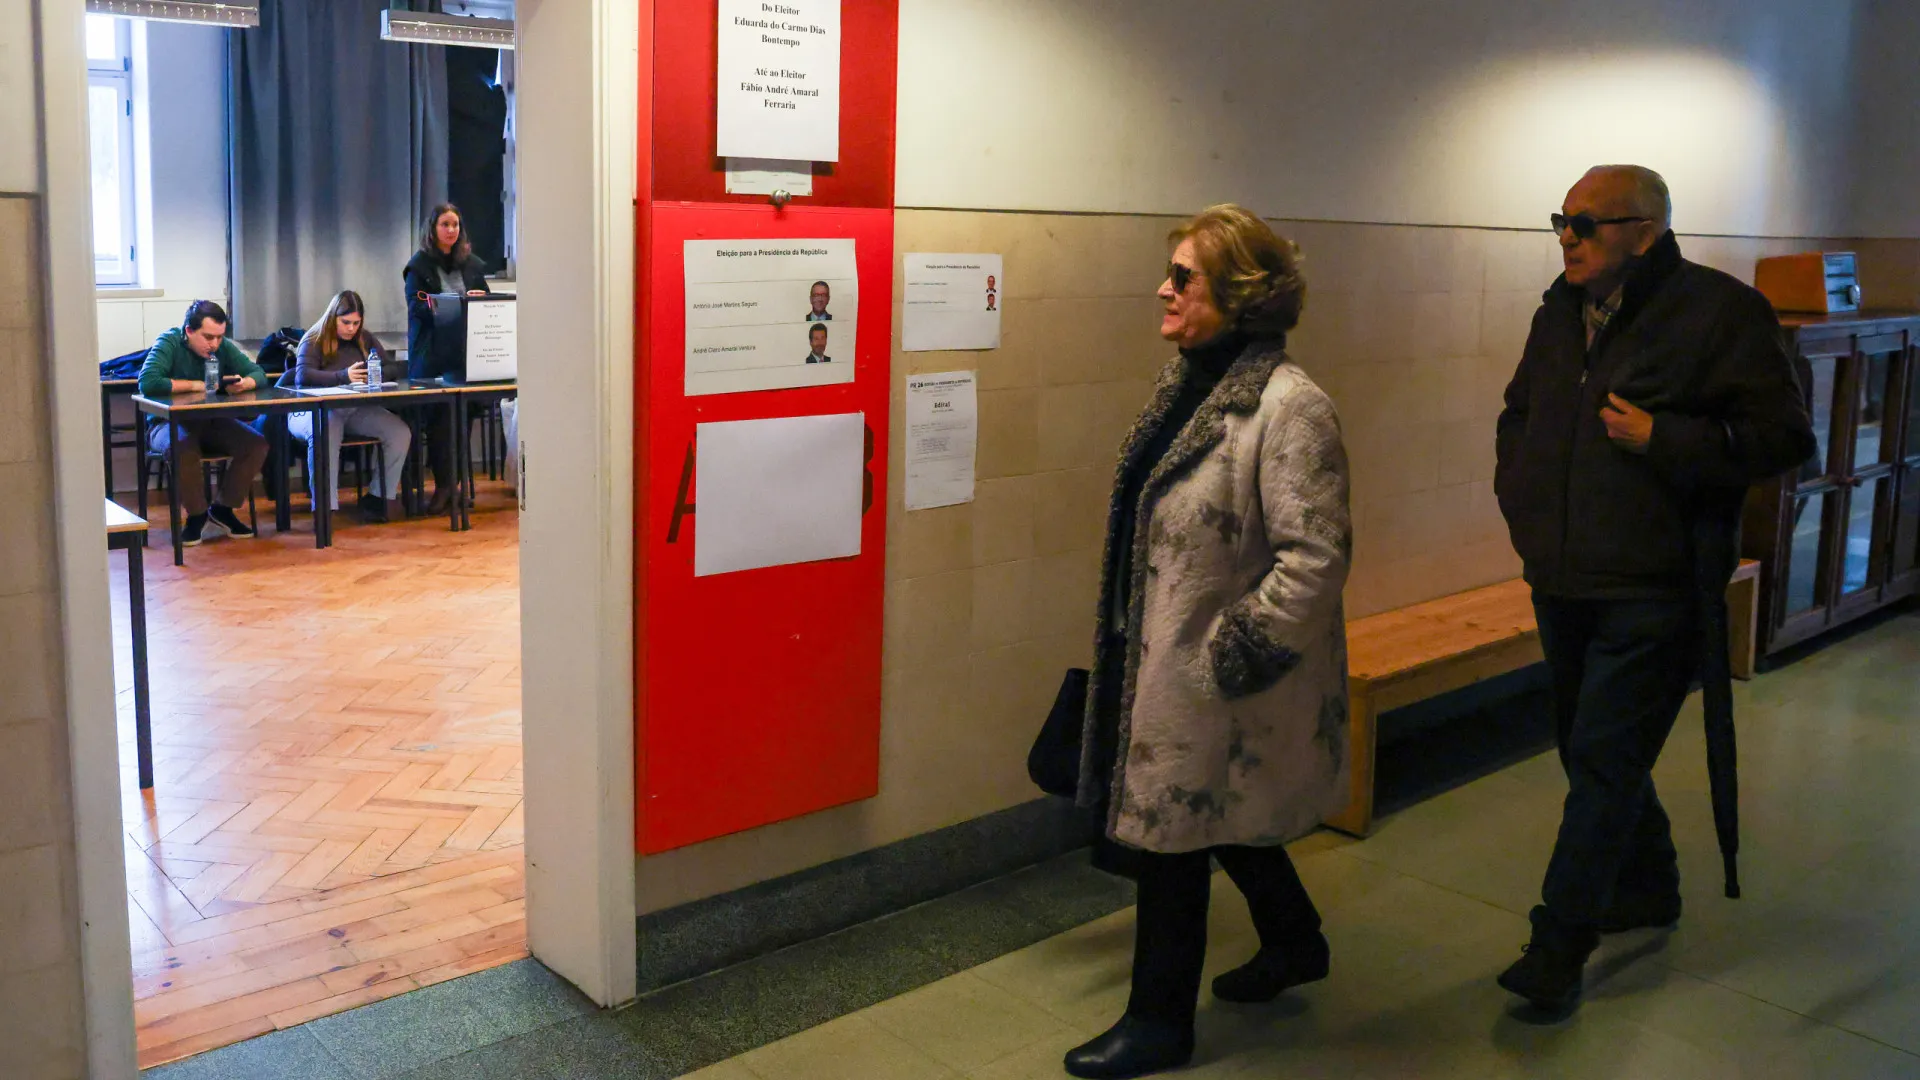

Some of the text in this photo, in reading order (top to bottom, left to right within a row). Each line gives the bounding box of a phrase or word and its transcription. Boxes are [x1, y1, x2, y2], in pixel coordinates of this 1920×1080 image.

[762, 3, 800, 16] Do Eleitor
[734, 16, 826, 35] Eduarda do Carmo Dias
[761, 34, 800, 48] Bontempo
[755, 67, 806, 80] Até ao Eleitor
[741, 82, 819, 97] Fábio André Amaral
[764, 99, 796, 110] Ferraria
[716, 250, 738, 258] Eleição
[739, 250, 753, 258] para
[758, 249, 791, 257] Presidência
[792, 248, 800, 256] da
[800, 248, 828, 257] República
